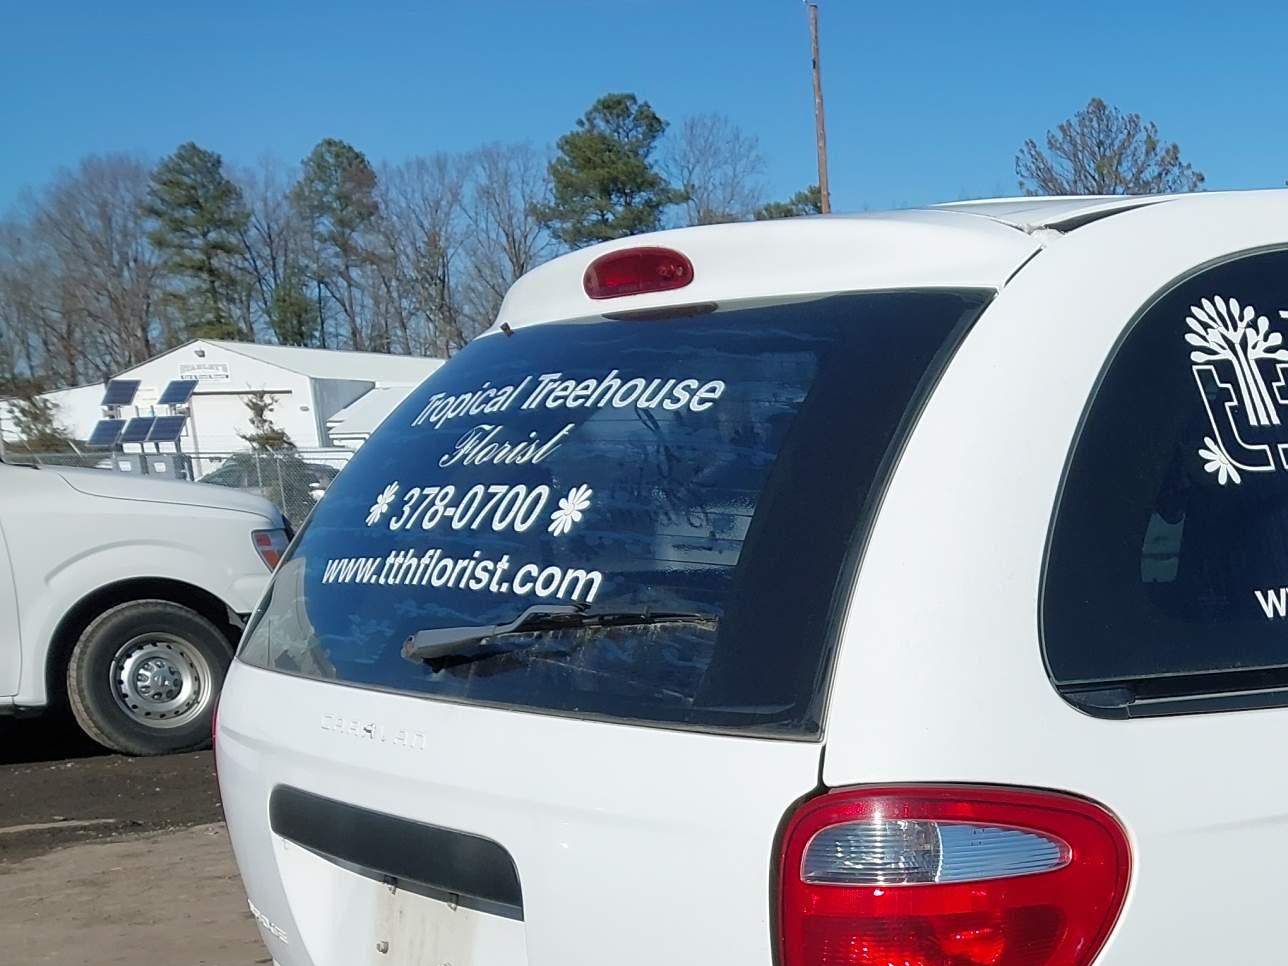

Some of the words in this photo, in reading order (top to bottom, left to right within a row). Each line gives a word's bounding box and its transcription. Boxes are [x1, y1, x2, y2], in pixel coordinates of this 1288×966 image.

[411, 376, 533, 430] Tropical
[523, 369, 726, 412] Treehouse
[438, 423, 575, 468] Florist
[388, 484, 550, 532] 378-0700
[321, 548, 602, 603] www.tthflorist.com
